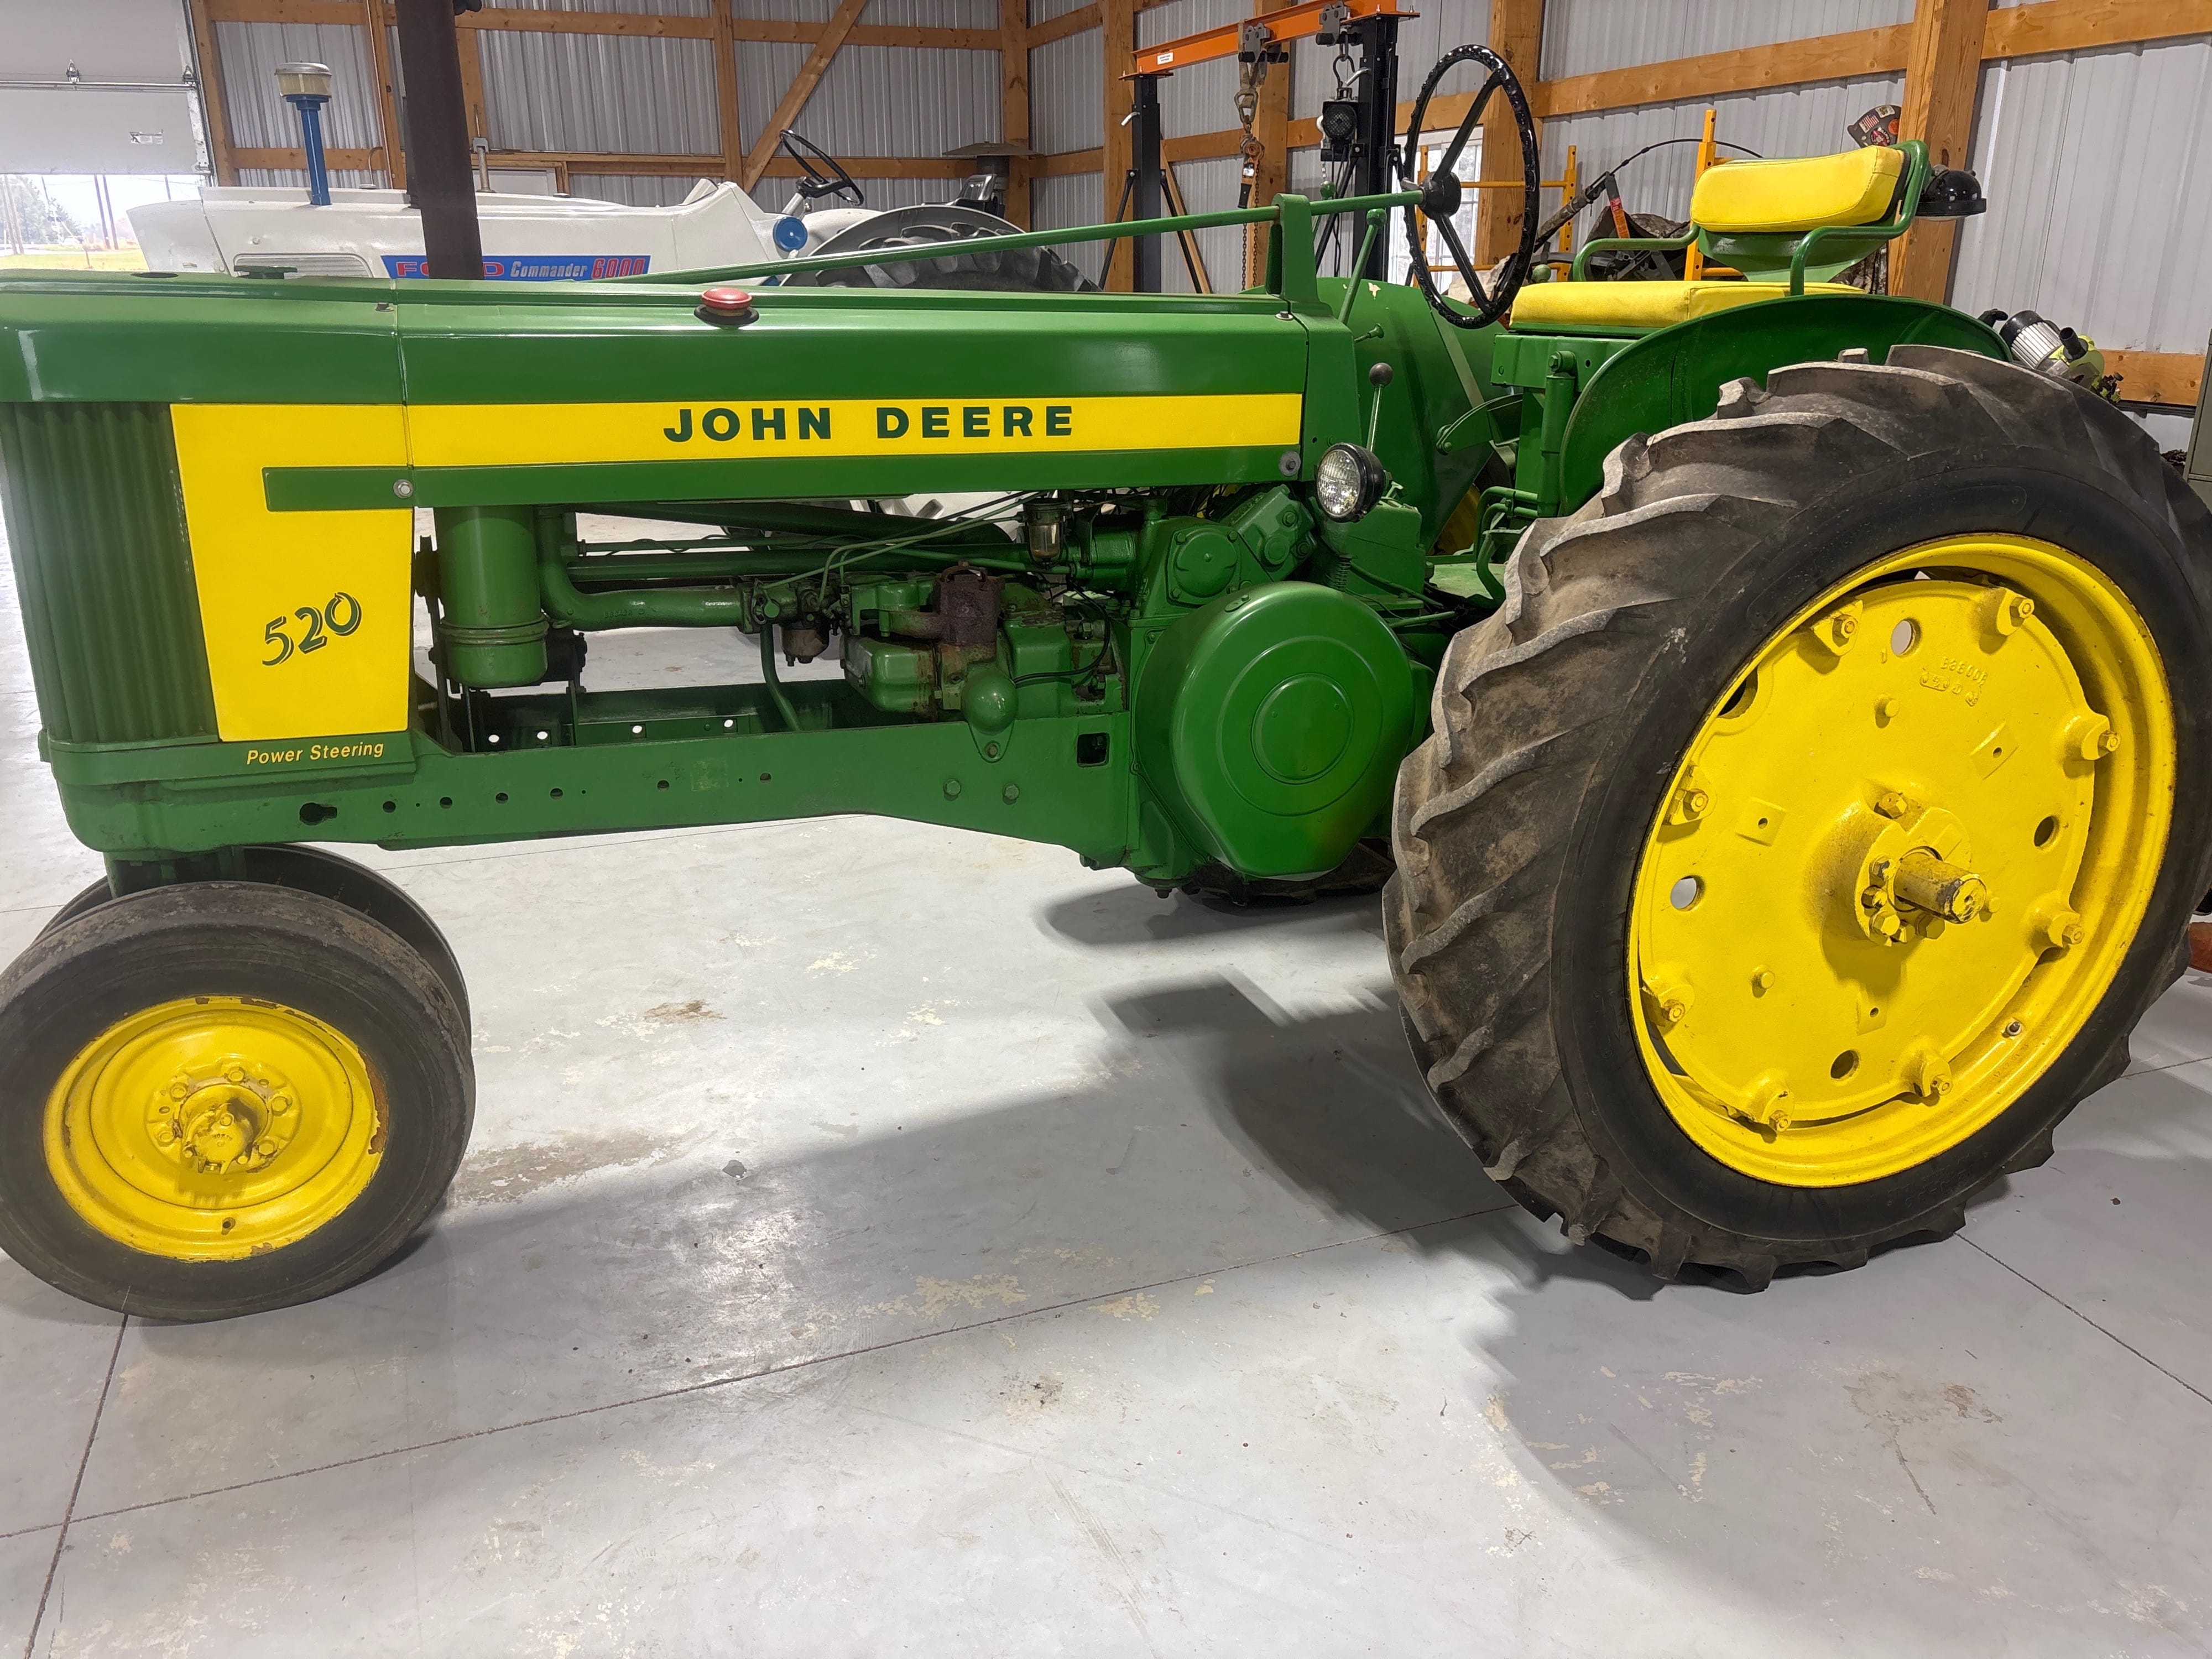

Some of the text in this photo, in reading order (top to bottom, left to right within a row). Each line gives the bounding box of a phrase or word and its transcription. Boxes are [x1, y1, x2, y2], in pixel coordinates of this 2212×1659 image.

[396, 258, 645, 279] FD Commander 6000
[664, 406, 1073, 442] JOHN DEERE
[262, 592, 362, 666] 520
[247, 742, 384, 765] Power Steering
